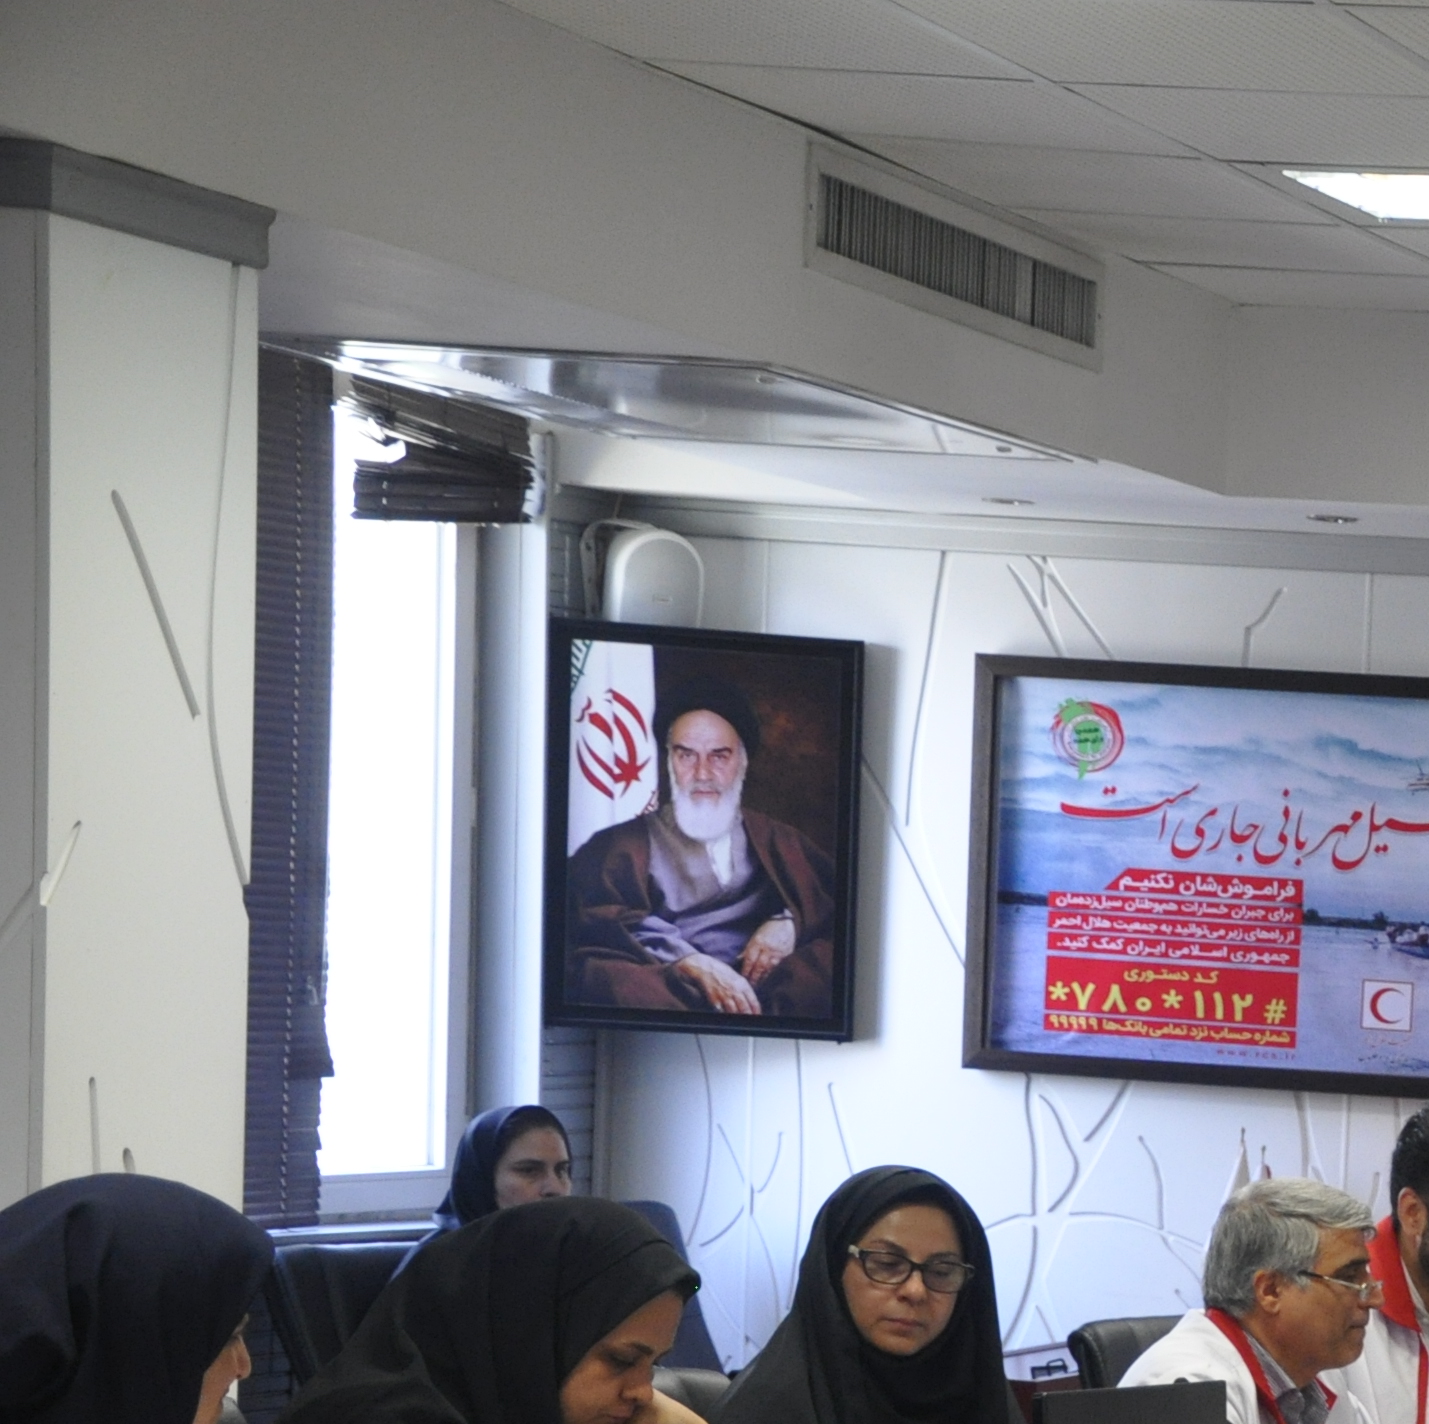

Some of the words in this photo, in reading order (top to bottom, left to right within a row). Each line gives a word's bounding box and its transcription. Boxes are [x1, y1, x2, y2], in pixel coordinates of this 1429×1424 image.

[1060, 784, 1199, 840] است
[1171, 805, 1261, 862] جاری
[1253, 788, 1364, 868] مهربانی
[1119, 873, 1174, 892] نکنیم
[1124, 897, 1179, 914] هموطنان
[1181, 901, 1228, 916] خسارات
[1231, 904, 1265, 919] جبران
[1053, 914, 1082, 928] احمر
[1267, 906, 1294, 922] برای
[1082, 916, 1112, 930] هلال
[1113, 918, 1158, 931] جمعیت
[1159, 922, 1173, 934] به
[1226, 925, 1243, 941] زیر
[1286, 930, 1295, 942] از
[1092, 938, 1124, 950] کمک
[1127, 941, 1166, 956] ایران
[1167, 943, 1227, 958] اسلامی
[1229, 947, 1290, 964] جمهوری
[1123, 968, 1190, 983] دستوری
[1193, 970, 1219, 984] کد
[1149, 1024, 1188, 1038] تمامی
[1190, 1028, 1209, 1039] نزد
[1210, 1030, 1252, 1041] حساب
[1253, 1031, 1290, 1045] شماره
